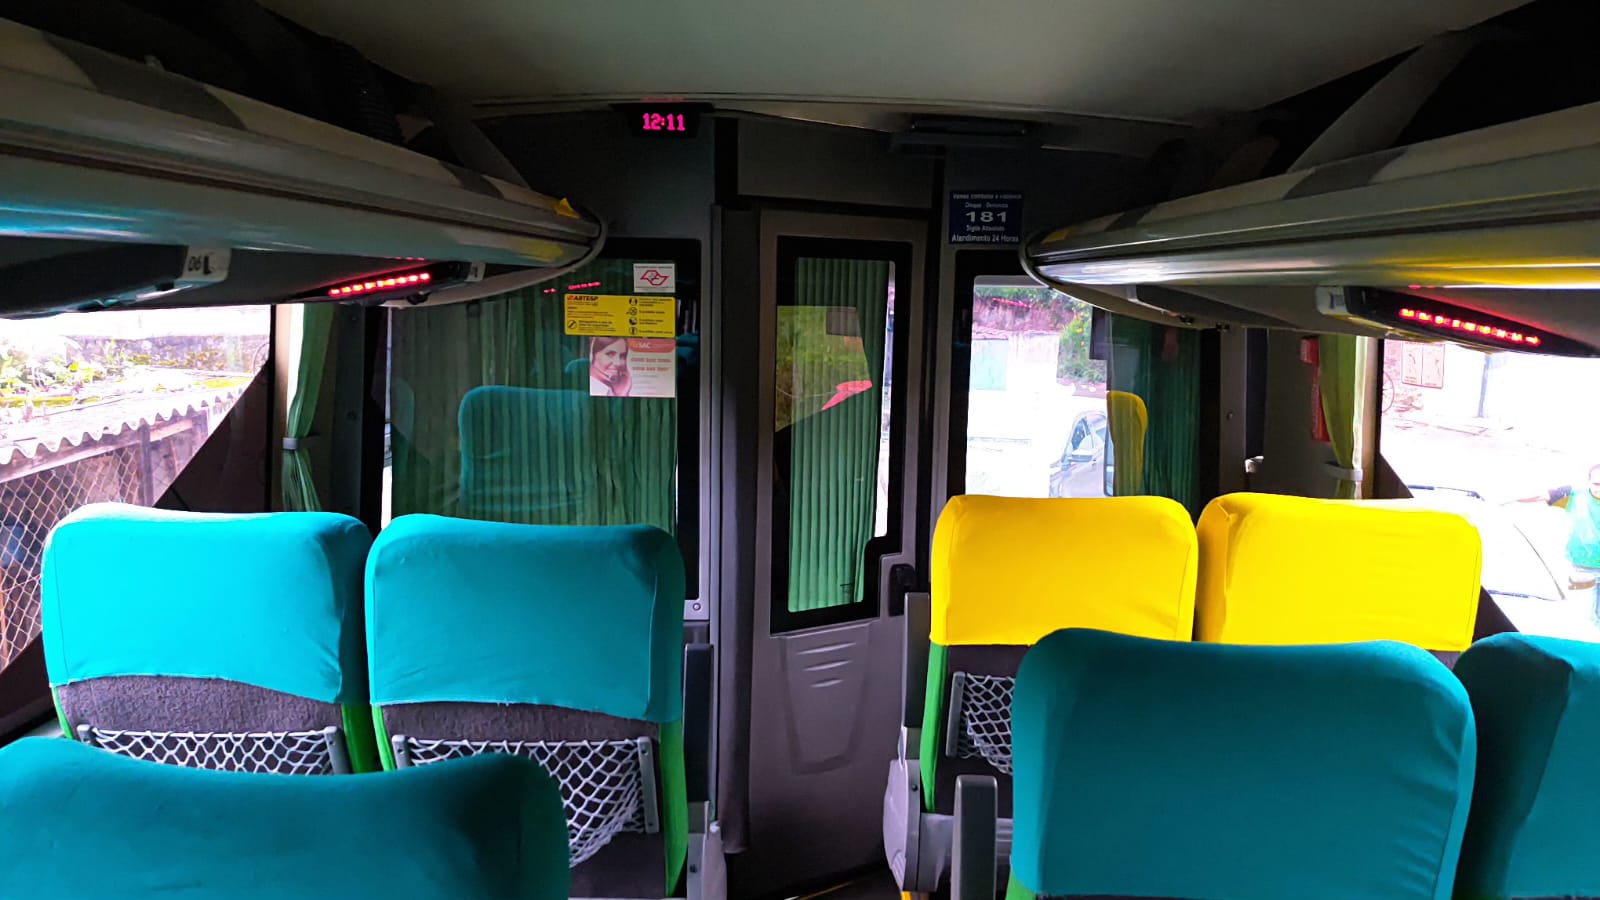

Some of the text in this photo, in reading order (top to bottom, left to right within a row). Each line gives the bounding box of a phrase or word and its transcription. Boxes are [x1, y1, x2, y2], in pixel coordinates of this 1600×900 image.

[642, 112, 686, 131] 12:11
[965, 211, 1007, 223] 181
[951, 233, 1019, 242] Atendimento 24 Horas
